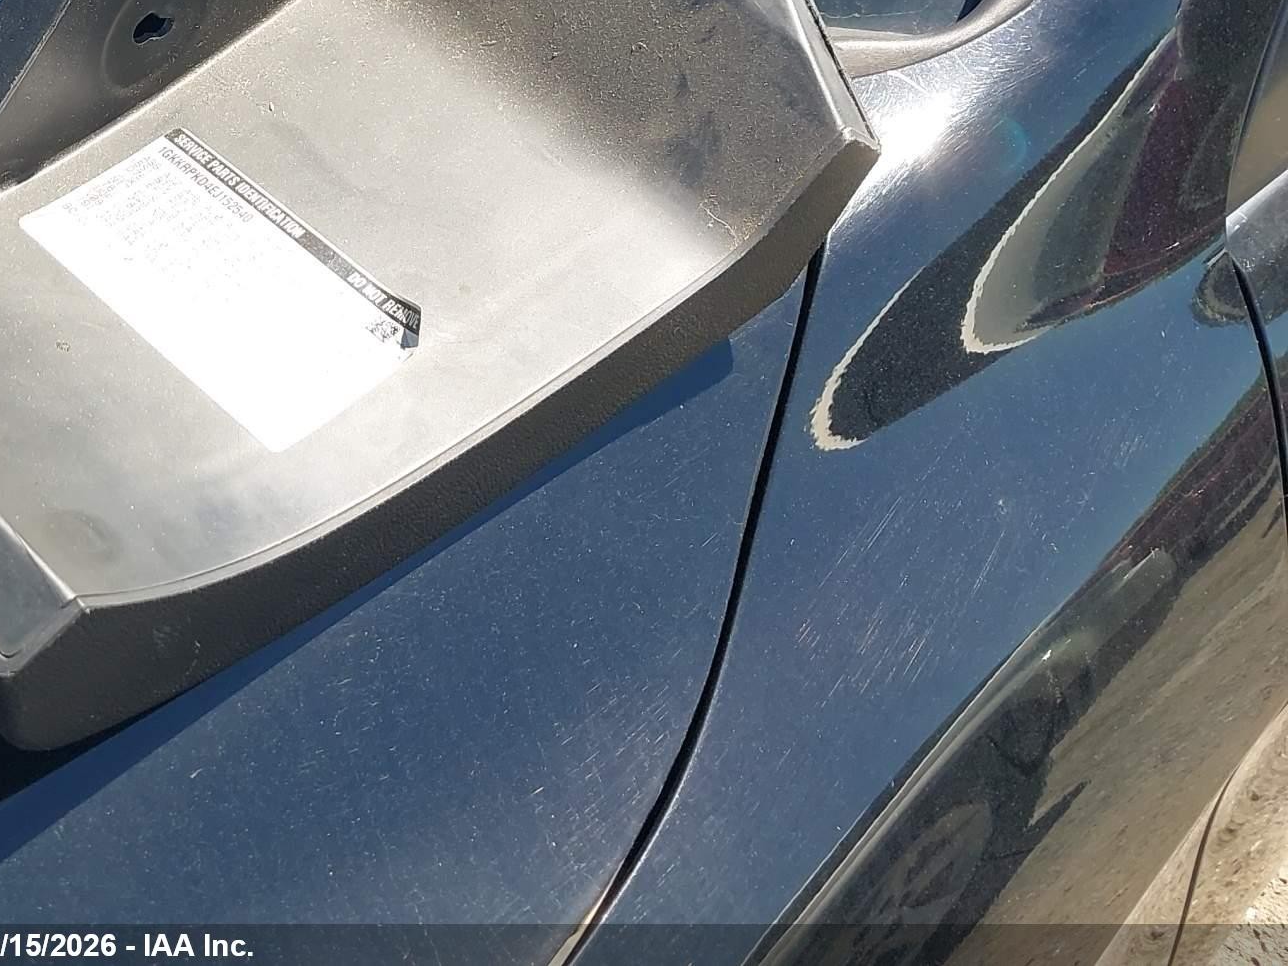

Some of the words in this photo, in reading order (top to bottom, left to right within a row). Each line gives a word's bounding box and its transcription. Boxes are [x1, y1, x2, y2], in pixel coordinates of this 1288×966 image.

[175, 134, 212, 165] SERVICE
[208, 158, 241, 186] PARTS
[235, 178, 307, 239] IDENTIFICATION
[346, 271, 368, 289] DO
[362, 282, 388, 306] NOT
[382, 298, 420, 330] REMOVE
